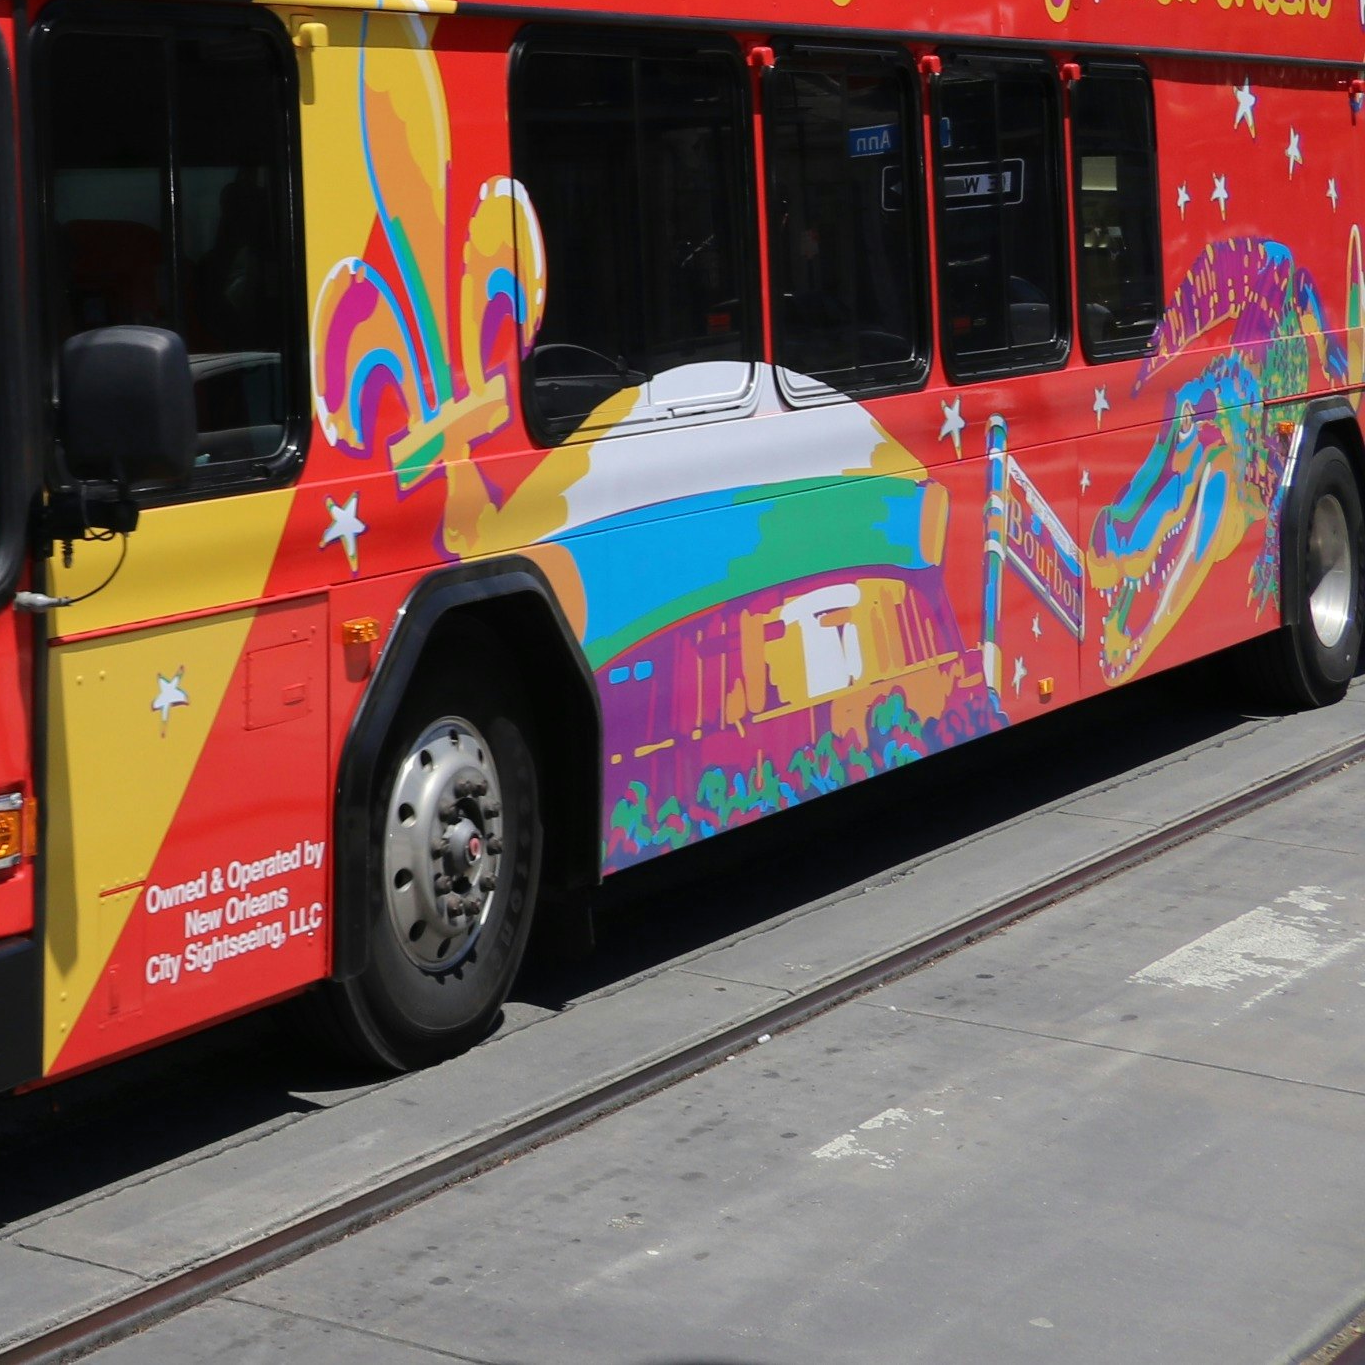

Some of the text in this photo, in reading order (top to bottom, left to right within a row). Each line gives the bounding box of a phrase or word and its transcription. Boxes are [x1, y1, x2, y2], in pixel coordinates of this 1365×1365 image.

[146, 840, 326, 914] Owned & Operated by
[184, 887, 289, 939] New Orleans
[146, 902, 324, 985] City Sightseeing, LLC
